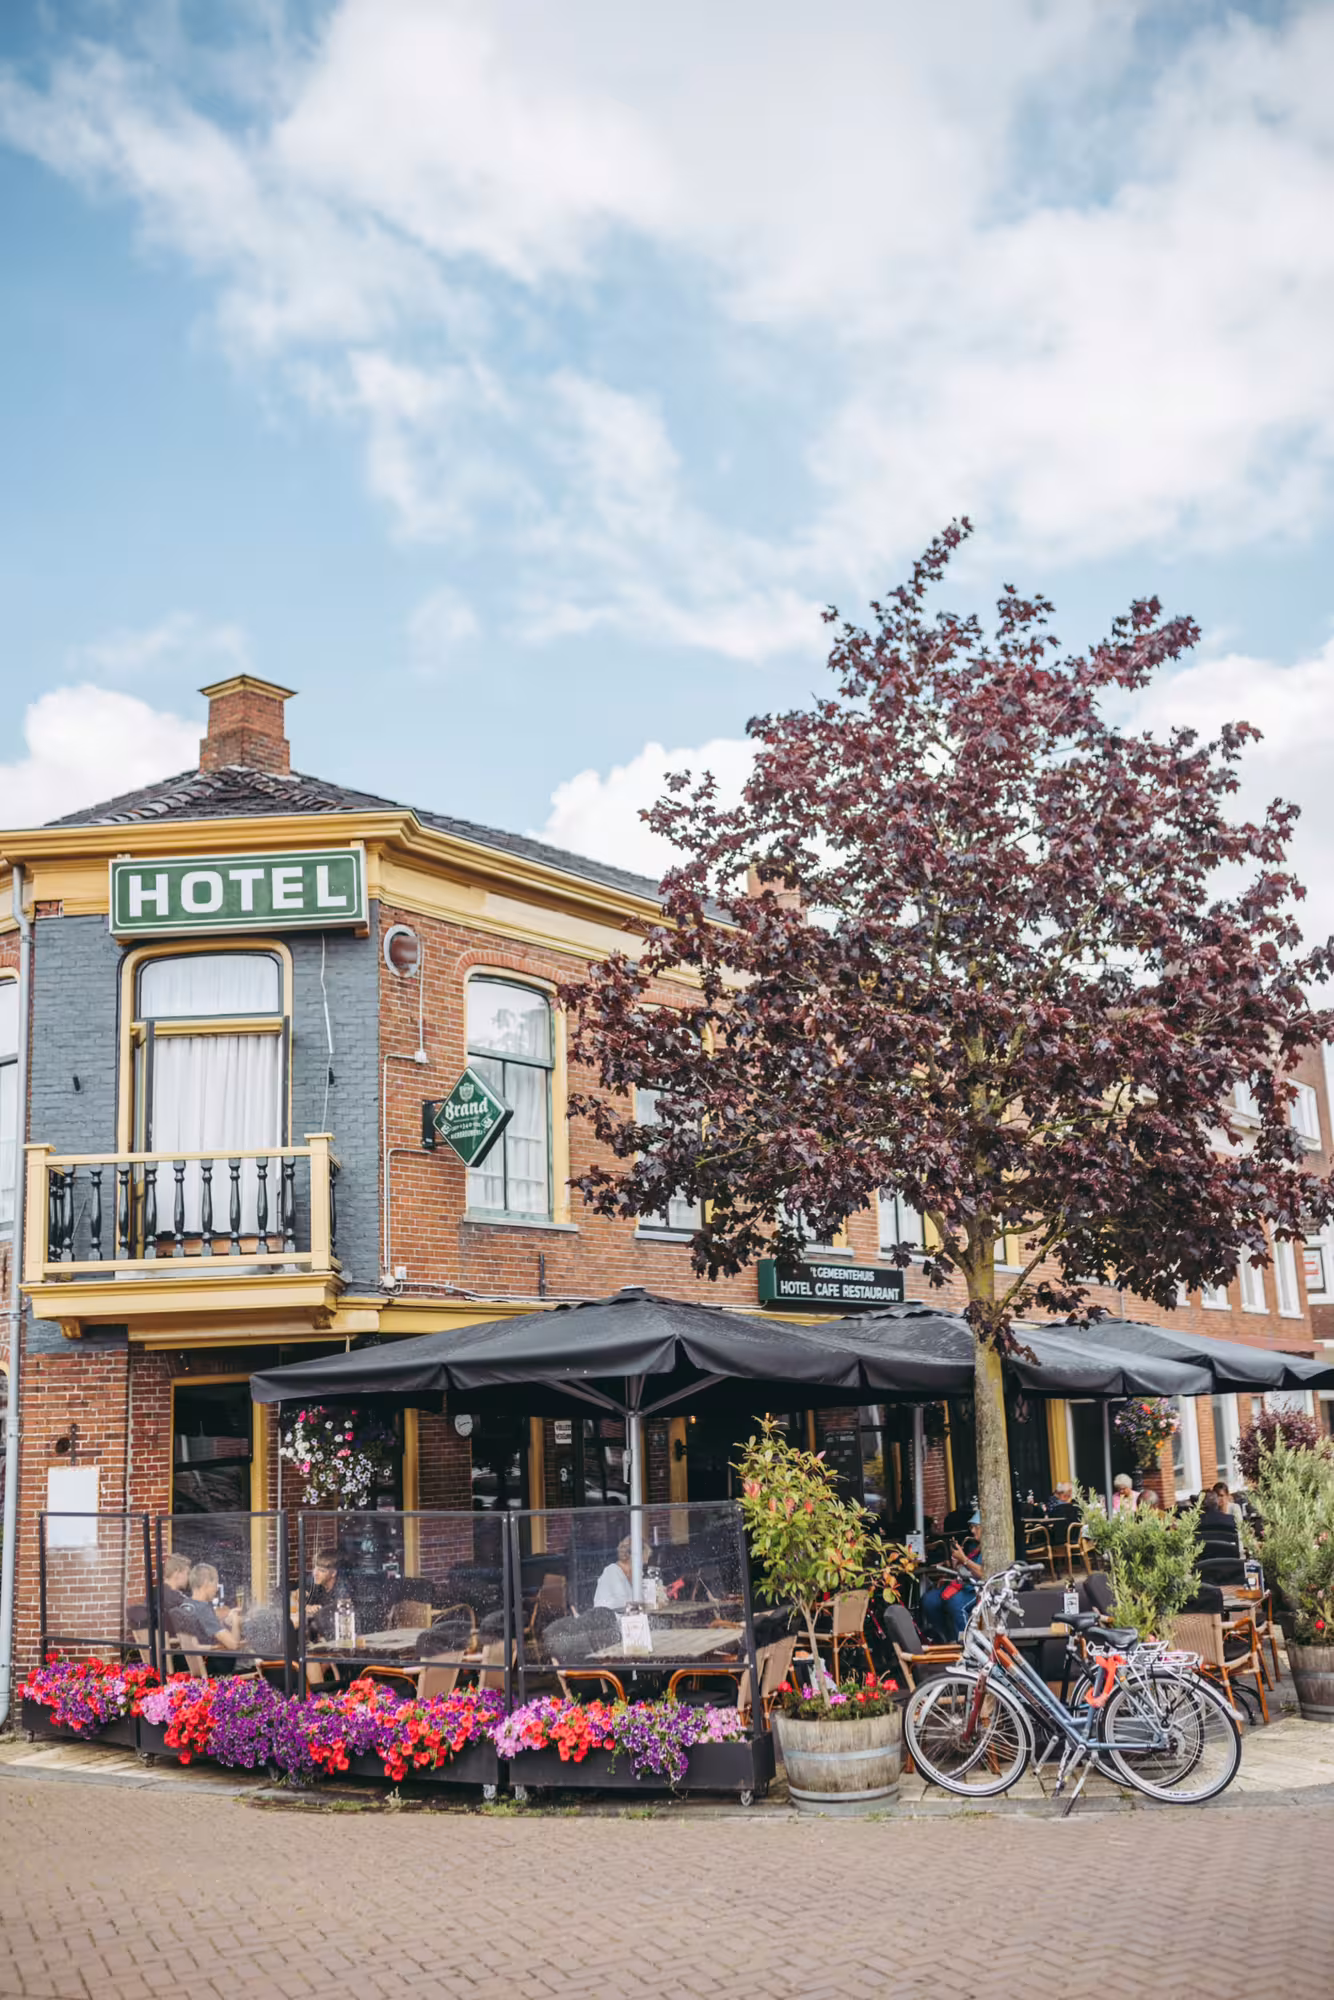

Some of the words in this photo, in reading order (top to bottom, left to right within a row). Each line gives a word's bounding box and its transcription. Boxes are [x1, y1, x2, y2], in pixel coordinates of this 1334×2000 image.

[129, 865, 347, 917] HOTEL
[445, 1096, 488, 1121] Brand
[810, 1266, 817, 1277] 't
[817, 1267, 875, 1281] GEMEENTEHUIS
[780, 1280, 813, 1295] HOTEL
[815, 1283, 840, 1297] CAFE
[842, 1285, 900, 1301] RESTAURANT
